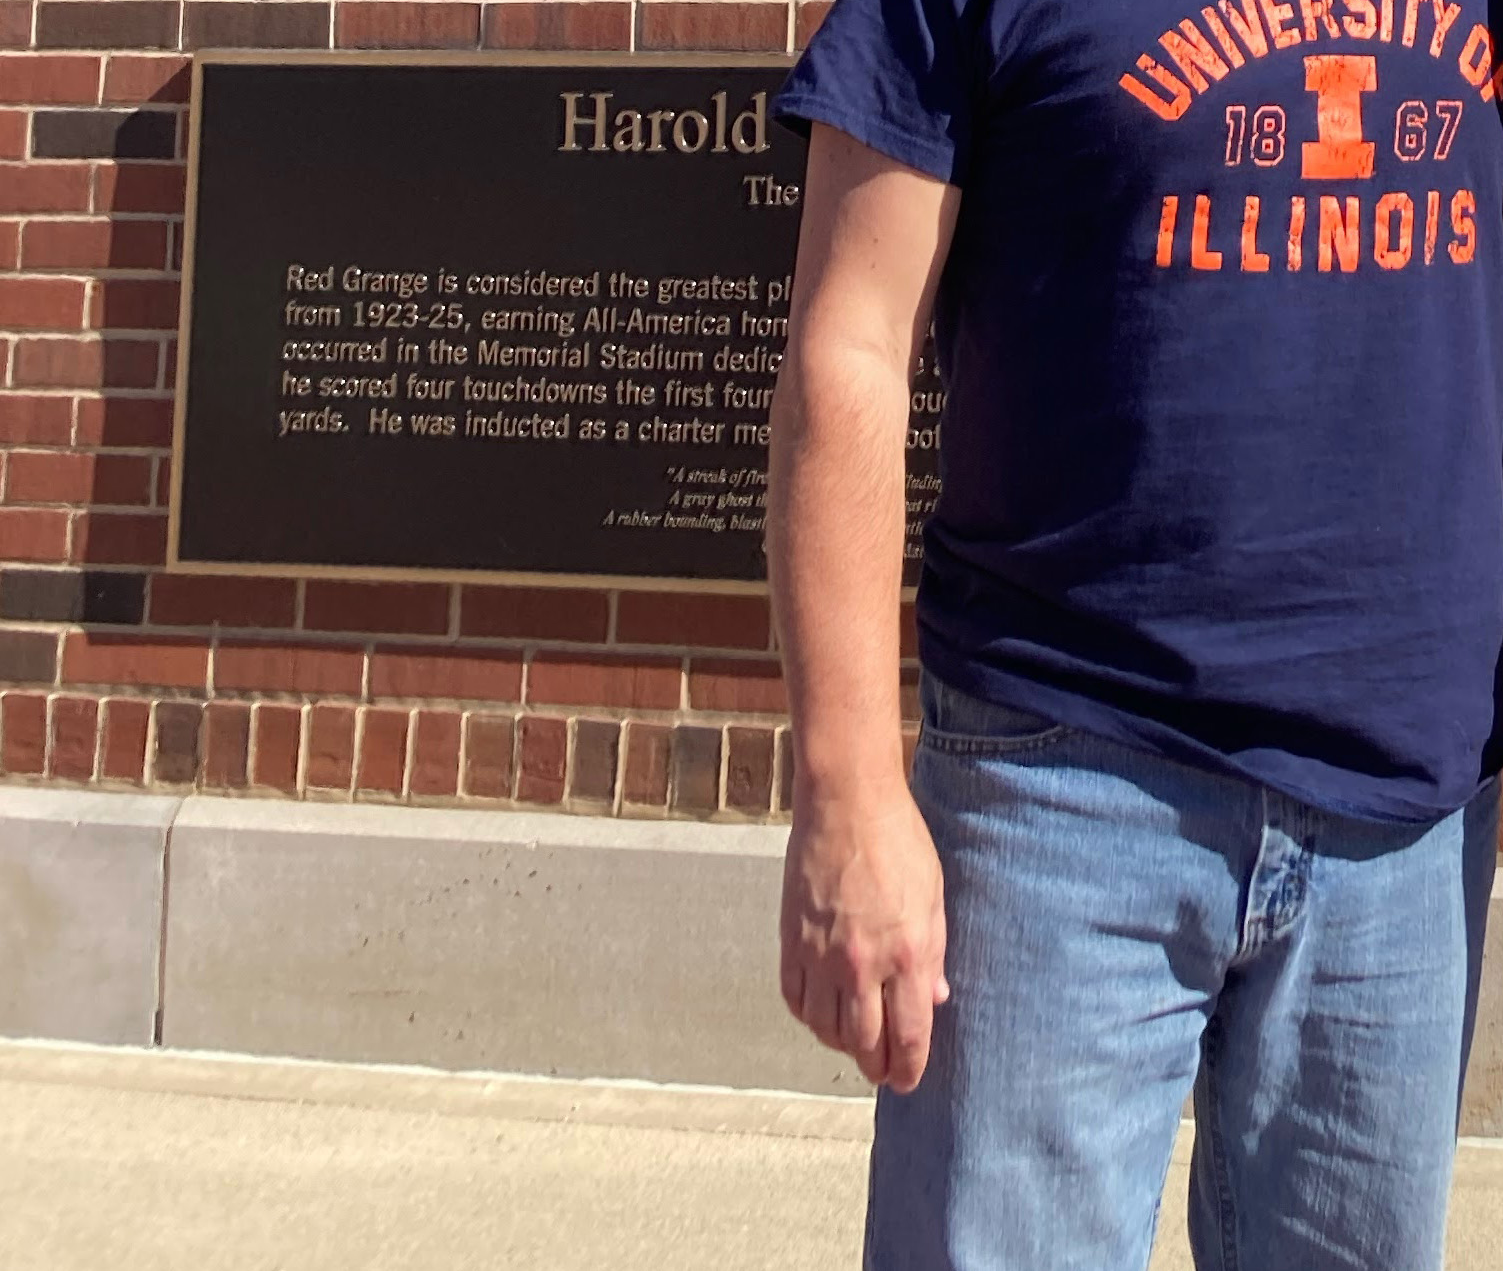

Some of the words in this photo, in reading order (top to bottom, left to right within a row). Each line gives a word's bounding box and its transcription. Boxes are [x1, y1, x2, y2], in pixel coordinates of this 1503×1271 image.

[557, 91, 771, 154] Harold
[1224, 105, 1286, 167] 18
[1301, 54, 1377, 180] I
[1394, 100, 1463, 162] 67
[742, 173, 800, 206] The
[1156, 189, 1476, 273] ILLINOIS
[286, 263, 335, 292] Red
[342, 264, 428, 299] Grange
[437, 267, 459, 294] is
[465, 269, 600, 298] considered
[608, 270, 650, 298] the
[656, 273, 759, 305] greatest
[284, 300, 342, 327] from
[353, 301, 471, 334] 1923-25,
[480, 305, 576, 338] earning
[583, 307, 731, 336] All-America
[283, 336, 388, 361] occurred
[397, 337, 420, 364] in
[428, 338, 469, 365] the
[477, 339, 590, 368] Memorial
[600, 341, 704, 370] Stadium
[282, 370, 312, 397] he
[318, 371, 398, 399] scored
[406, 372, 456, 400] four
[463, 375, 608, 405] touchdowns
[614, 378, 657, 406] the
[664, 379, 715, 408] first
[278, 406, 350, 437] yards.
[368, 407, 403, 435] He
[410, 413, 456, 436] was
[464, 409, 570, 440] inducted
[578, 418, 607, 440] as
[614, 419, 630, 441] a
[637, 415, 726, 444] charter
